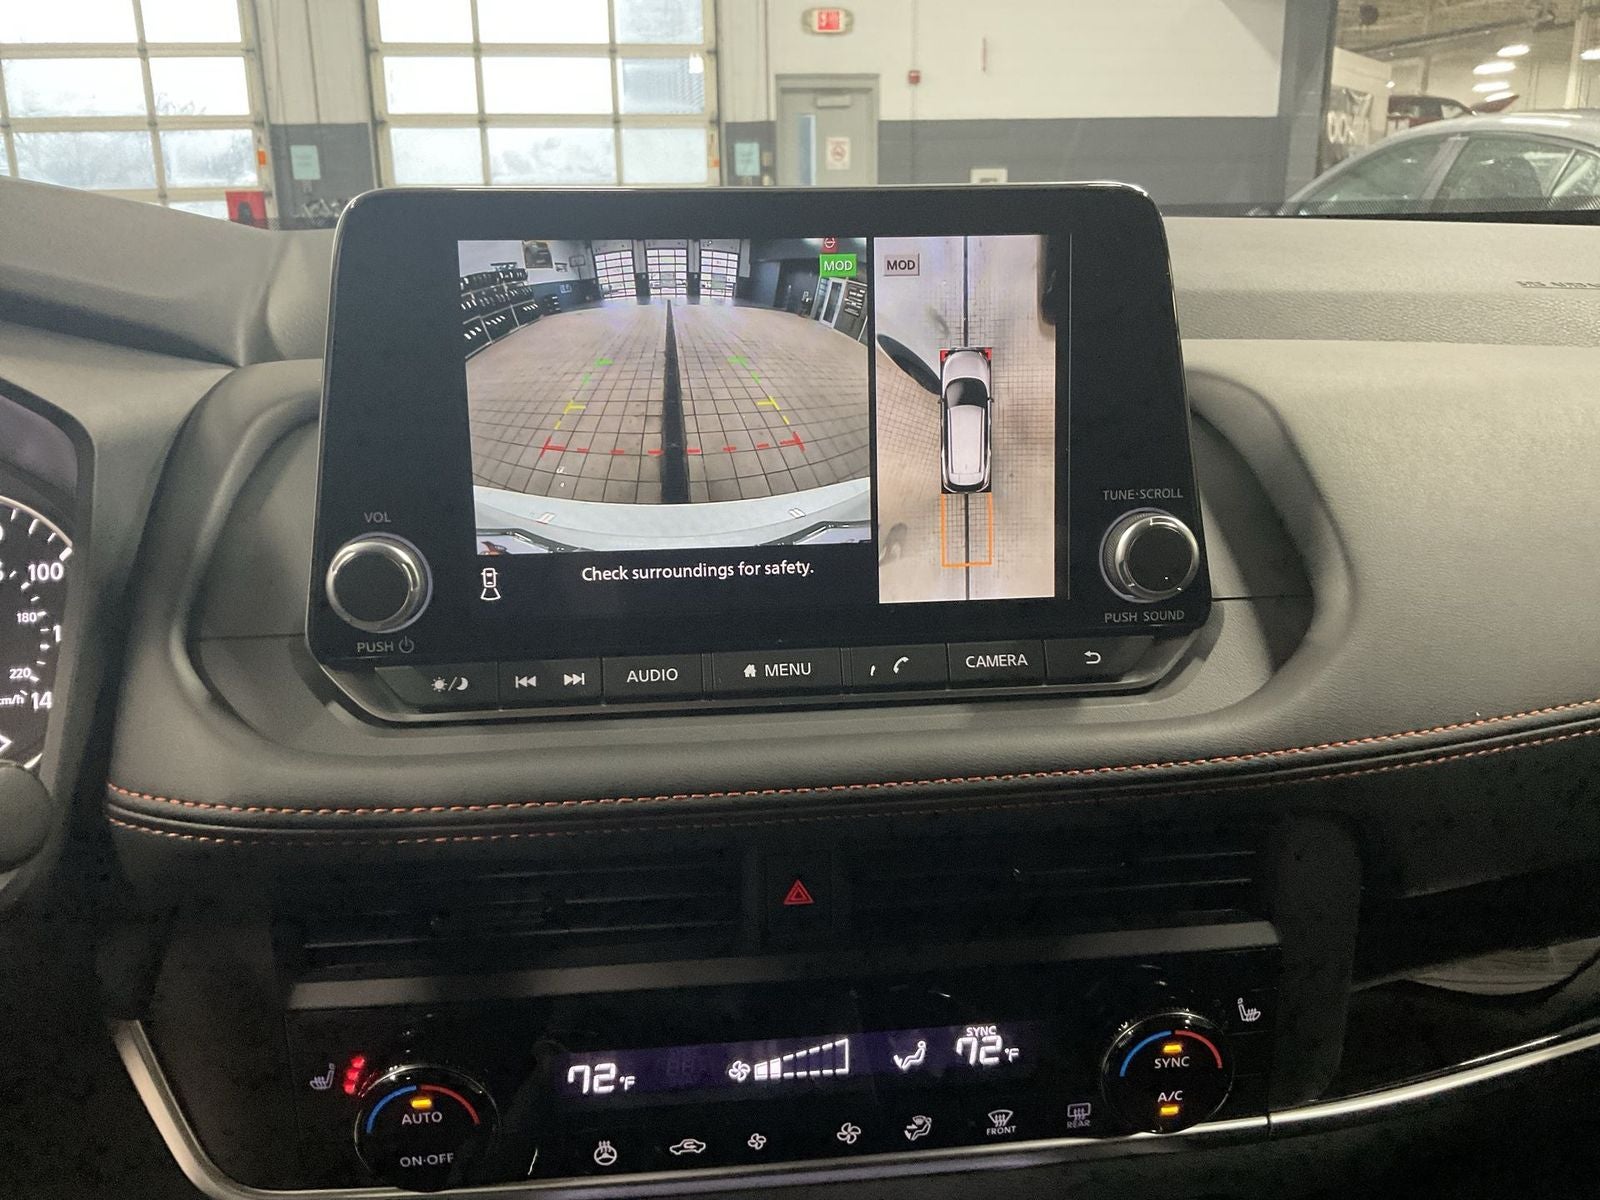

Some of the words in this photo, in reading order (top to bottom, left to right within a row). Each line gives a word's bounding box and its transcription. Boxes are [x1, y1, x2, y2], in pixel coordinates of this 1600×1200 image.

[823, 260, 853, 271] MOD
[886, 260, 916, 271] MOD
[363, 511, 392, 523] VOL
[28, 562, 64, 582] 100
[582, 566, 629, 582] Check
[631, 563, 735, 580] surroundings
[737, 561, 762, 576] for
[764, 559, 815, 577] safety.
[17, 612, 37, 623] 180
[1104, 612, 1138, 623] PUSH
[1143, 610, 1185, 621] SOUND
[356, 641, 394, 653] PUSH
[965, 653, 1029, 669] CAMERA
[9, 668, 32, 680] 220
[626, 668, 679, 683] AUDIO
[764, 662, 812, 677] MENU
[966, 1025, 997, 1037] SYNC
[1154, 1056, 1190, 1069] SYNC
[1157, 1090, 1183, 1102] A/C
[401, 1111, 443, 1125] AUTO
[986, 1125, 1017, 1136] FRONT
[1066, 1120, 1091, 1129] REAR
